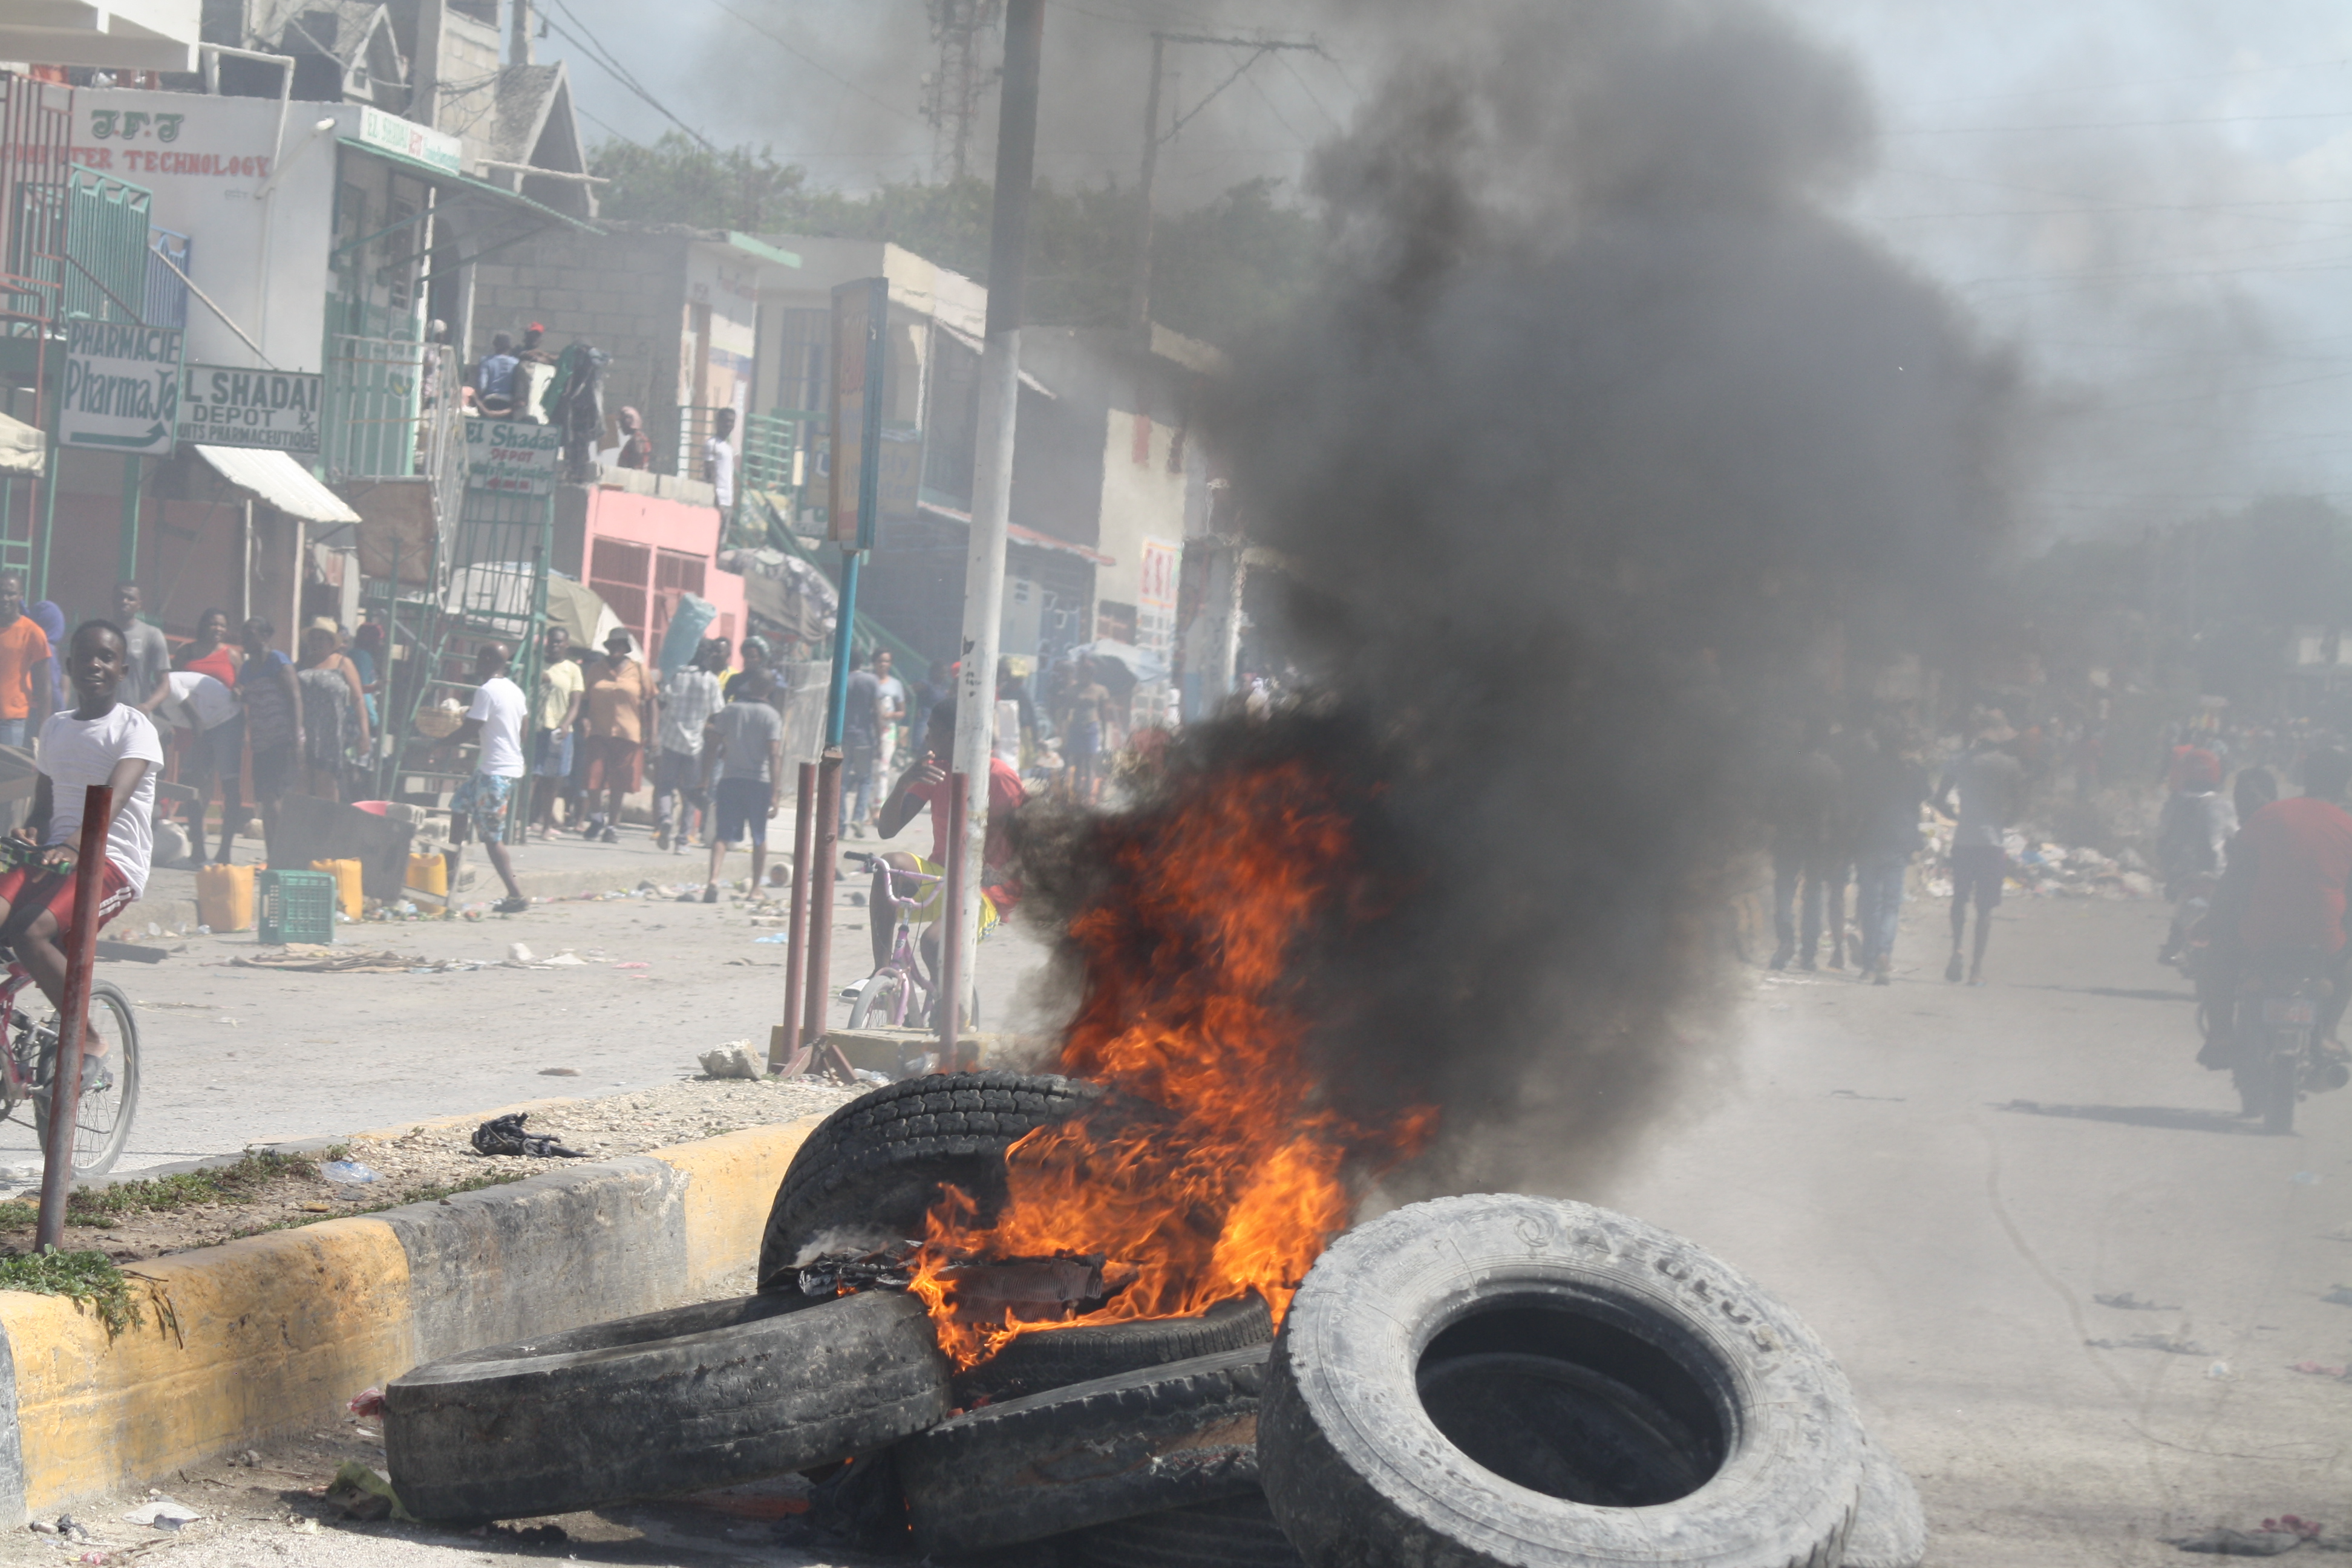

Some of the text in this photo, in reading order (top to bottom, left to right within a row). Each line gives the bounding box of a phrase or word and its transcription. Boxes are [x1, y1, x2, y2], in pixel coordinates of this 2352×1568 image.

[123, 150, 270, 177] TECHNOLOGY
[68, 322, 181, 364] PHARMACIE
[185, 370, 318, 412] L SHADAI
[192, 404, 277, 427] DEPOT
